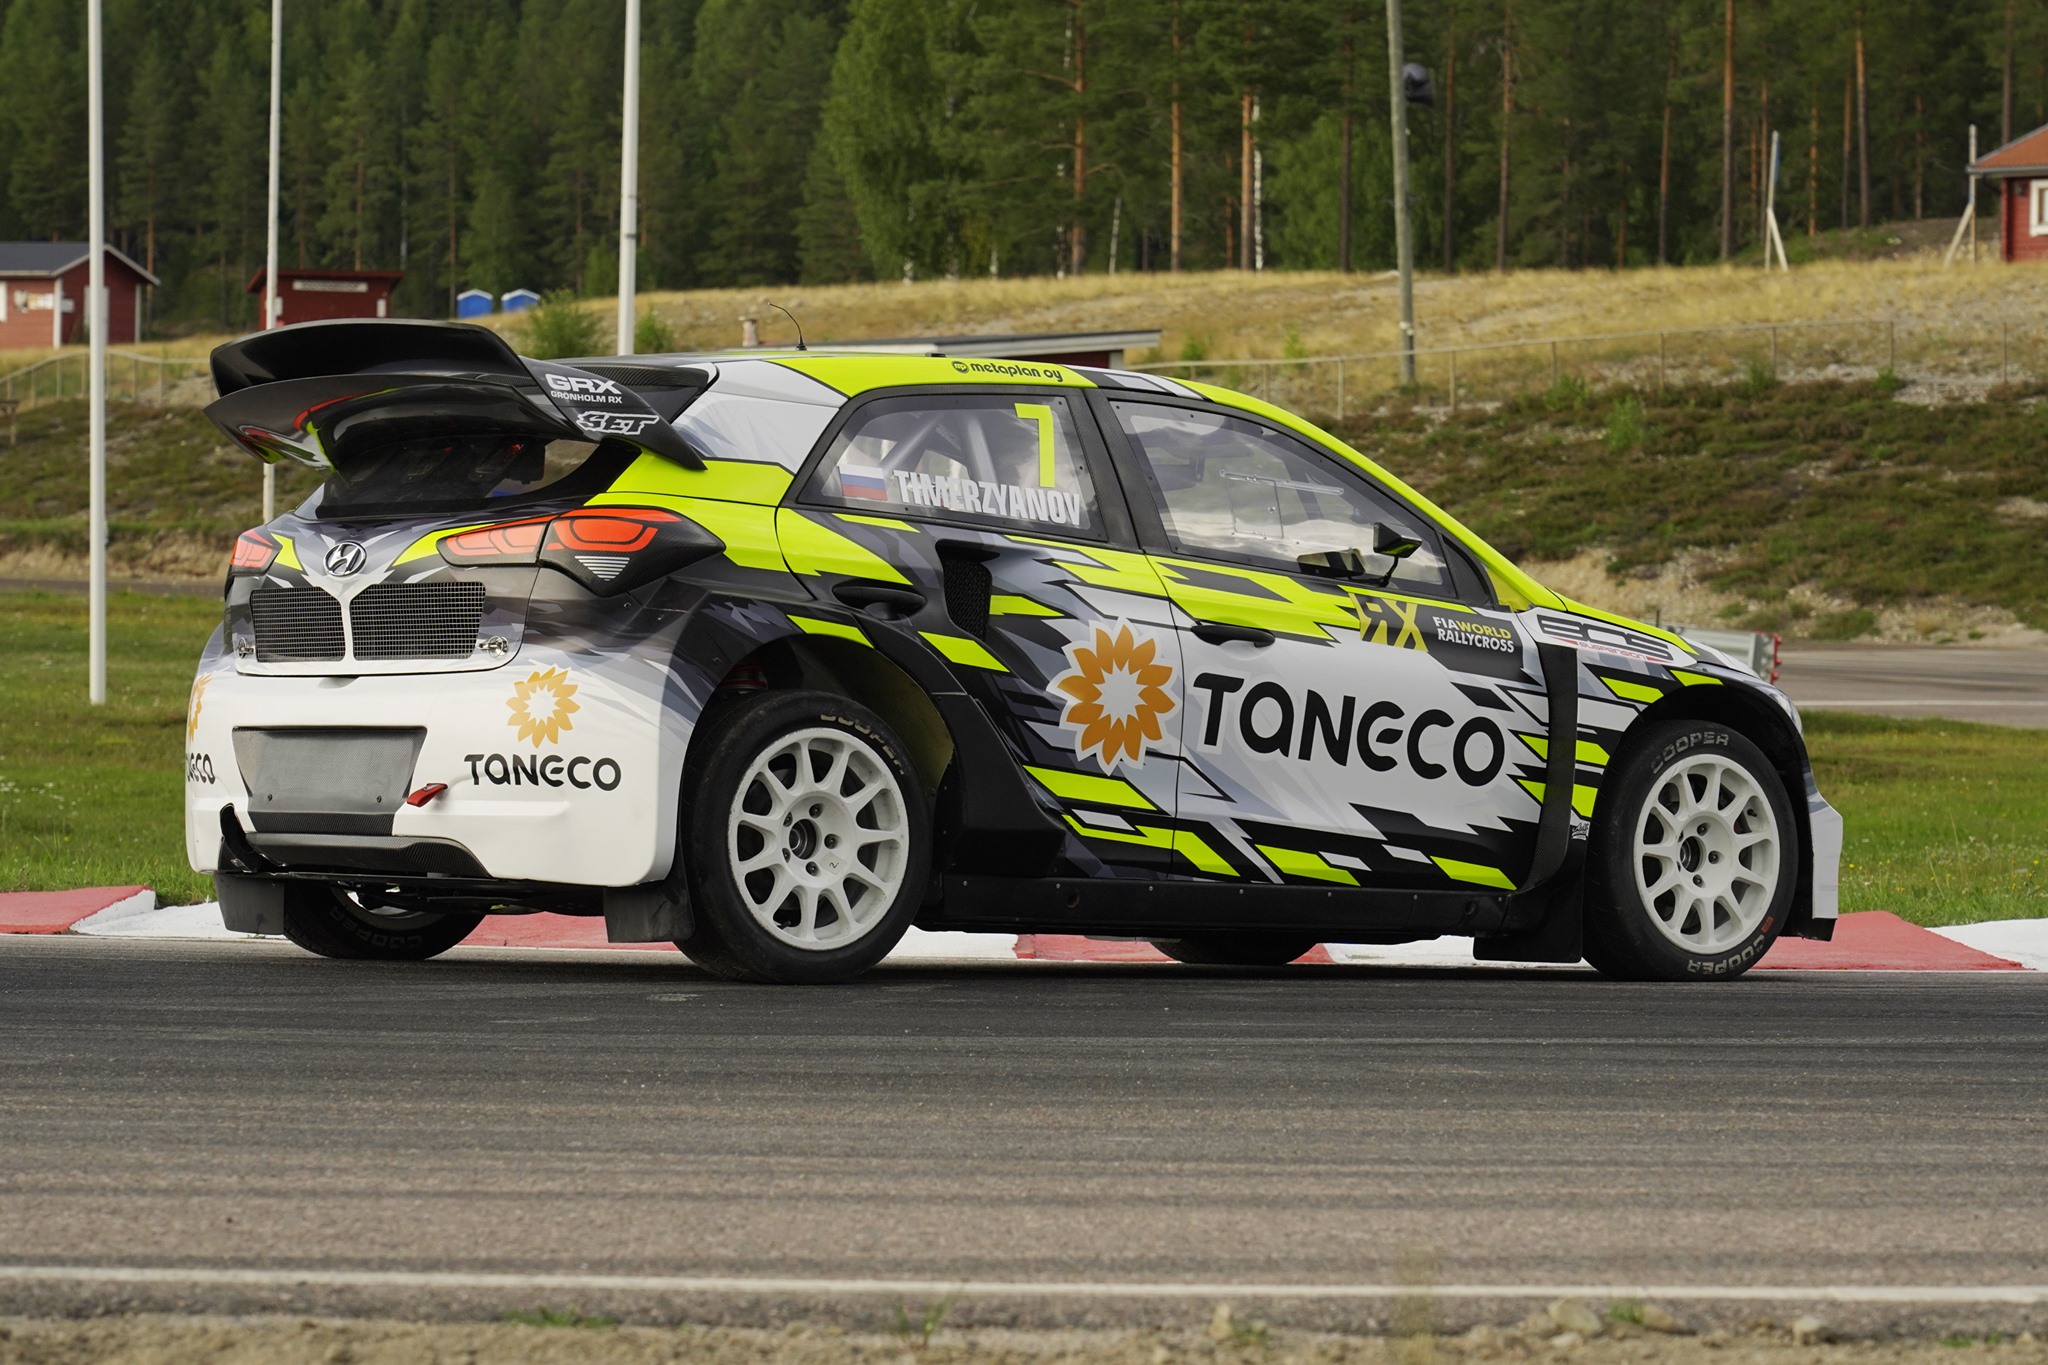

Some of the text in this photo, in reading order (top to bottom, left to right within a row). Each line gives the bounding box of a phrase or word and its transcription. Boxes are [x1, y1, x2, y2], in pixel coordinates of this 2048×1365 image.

[545, 374, 622, 394] GRX
[970, 363, 1041, 377] metaplan
[1043, 369, 1063, 382] oy
[550, 390, 622, 404] GRÖNHOLM RX
[576, 411, 660, 435] SET
[1014, 403, 1056, 488] 7
[894, 470, 1080, 526] TIMERZYANOV
[1438, 628, 1515, 653] RALLYCROSS
[1193, 672, 1505, 787] TANECO
[463, 753, 622, 791] TANECO
[1650, 731, 1729, 775] COOPER
[1687, 934, 1765, 975] COOPER
